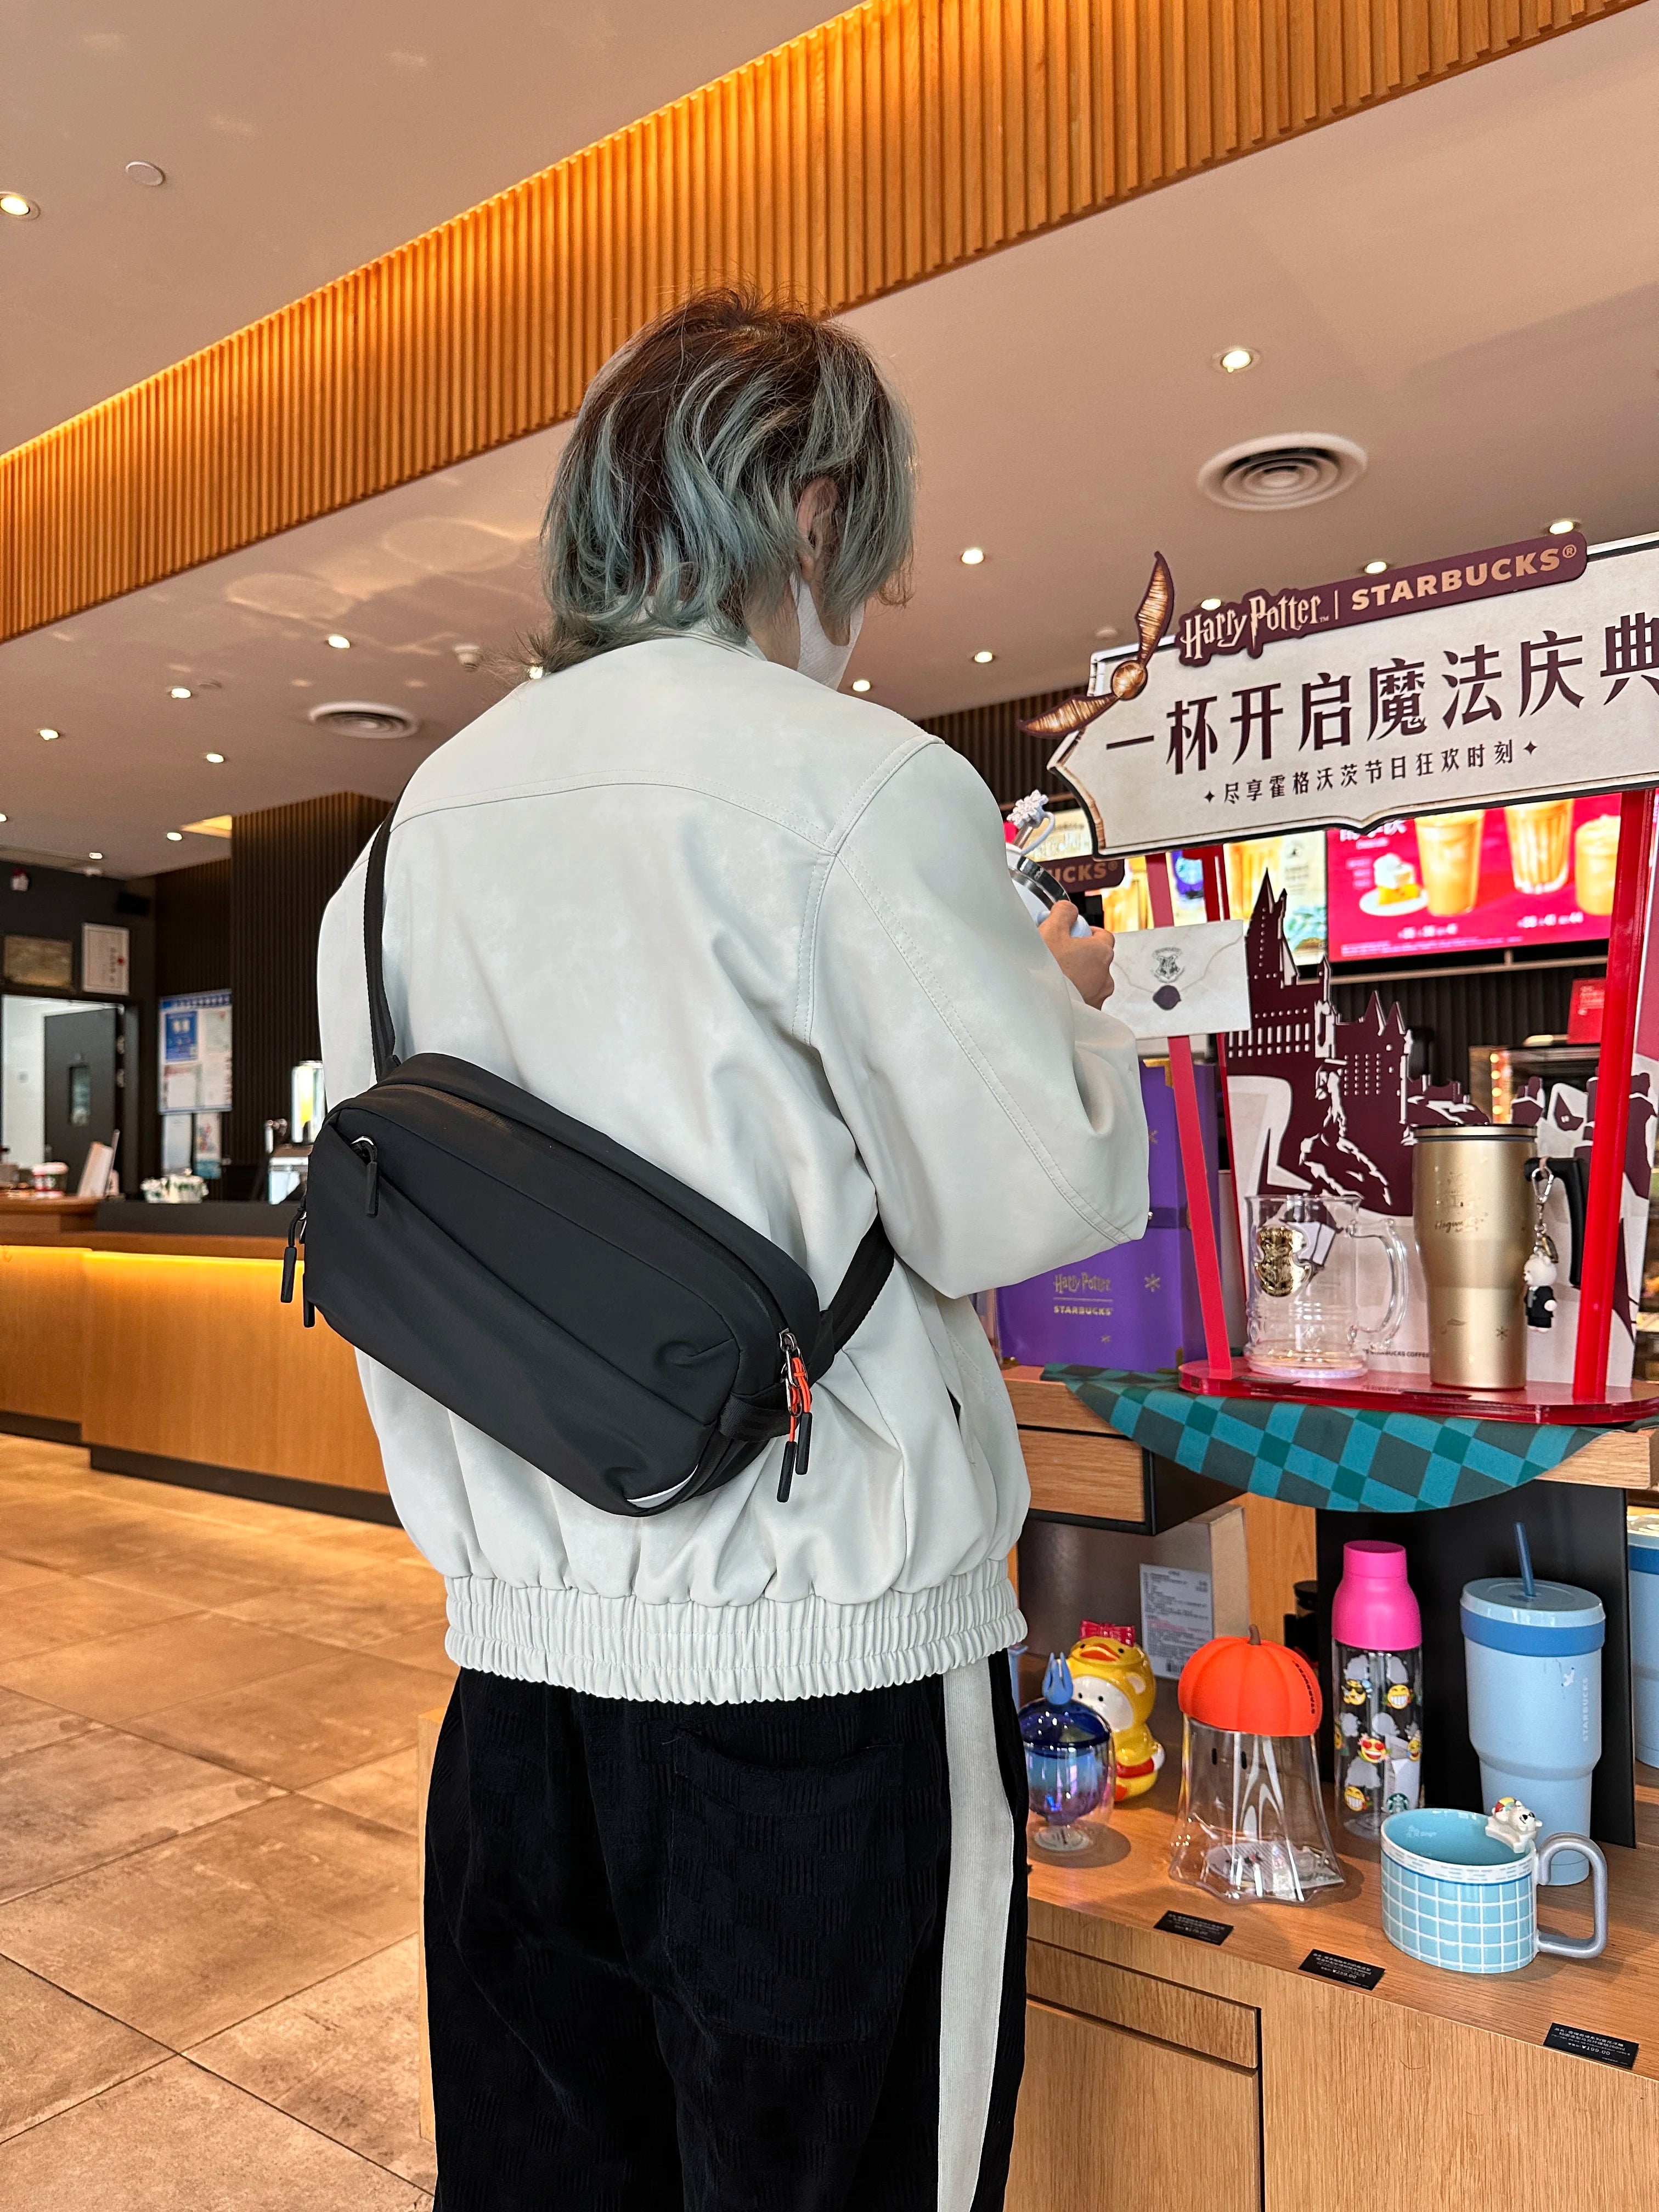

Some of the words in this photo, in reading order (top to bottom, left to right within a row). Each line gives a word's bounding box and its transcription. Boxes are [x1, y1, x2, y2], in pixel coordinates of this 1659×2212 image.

[1180, 609, 1248, 660] Harry
[1105, 612, 1659, 775] 一杯开启魔法庆典
[1224, 740, 1513, 805] 尽享霍格沃茨节日狂欢时刻
[1053, 1273, 1081, 1294] Harry
